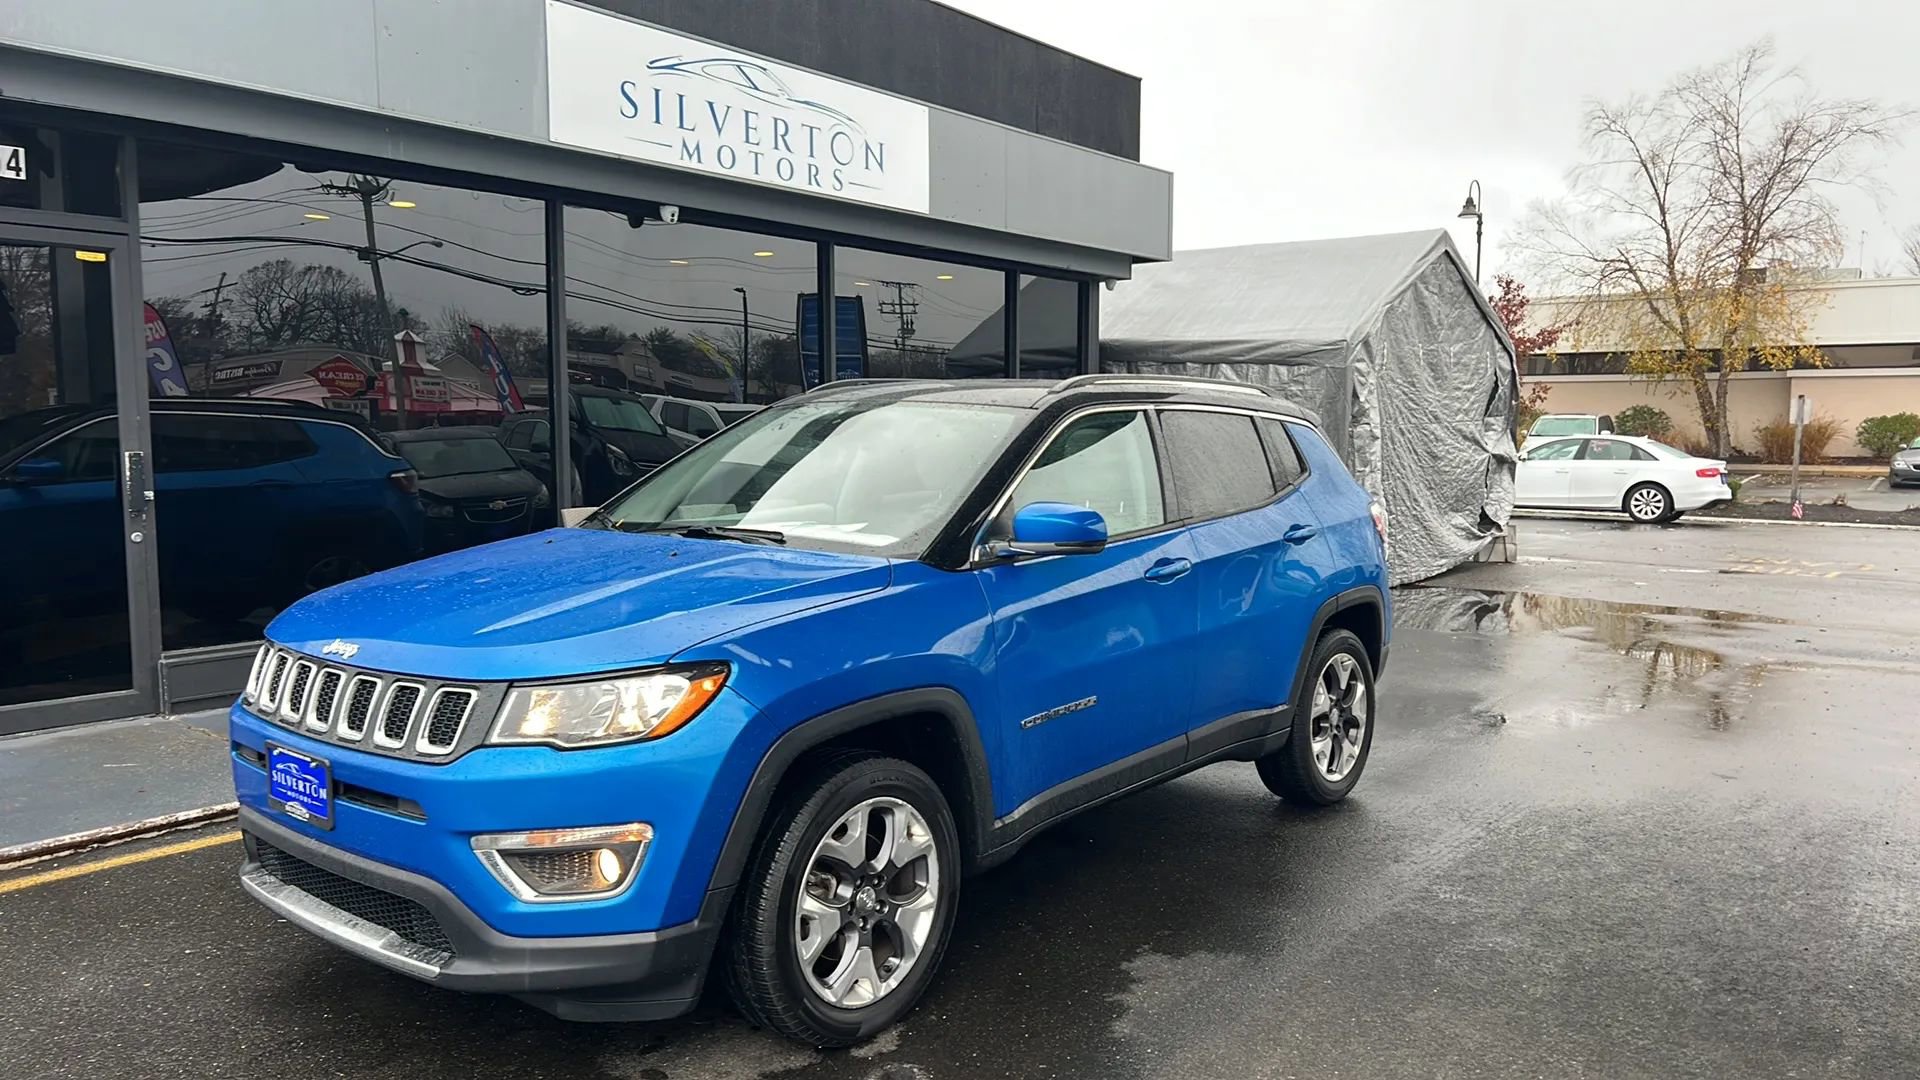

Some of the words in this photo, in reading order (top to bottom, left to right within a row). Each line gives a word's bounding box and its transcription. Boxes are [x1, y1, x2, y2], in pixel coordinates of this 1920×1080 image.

[619, 80, 884, 173] SILVERTON
[6, 148, 23, 177] 4
[680, 136, 844, 191] MOTORS
[322, 638, 360, 660] Jeep
[271, 769, 327, 800] SILVERTON
